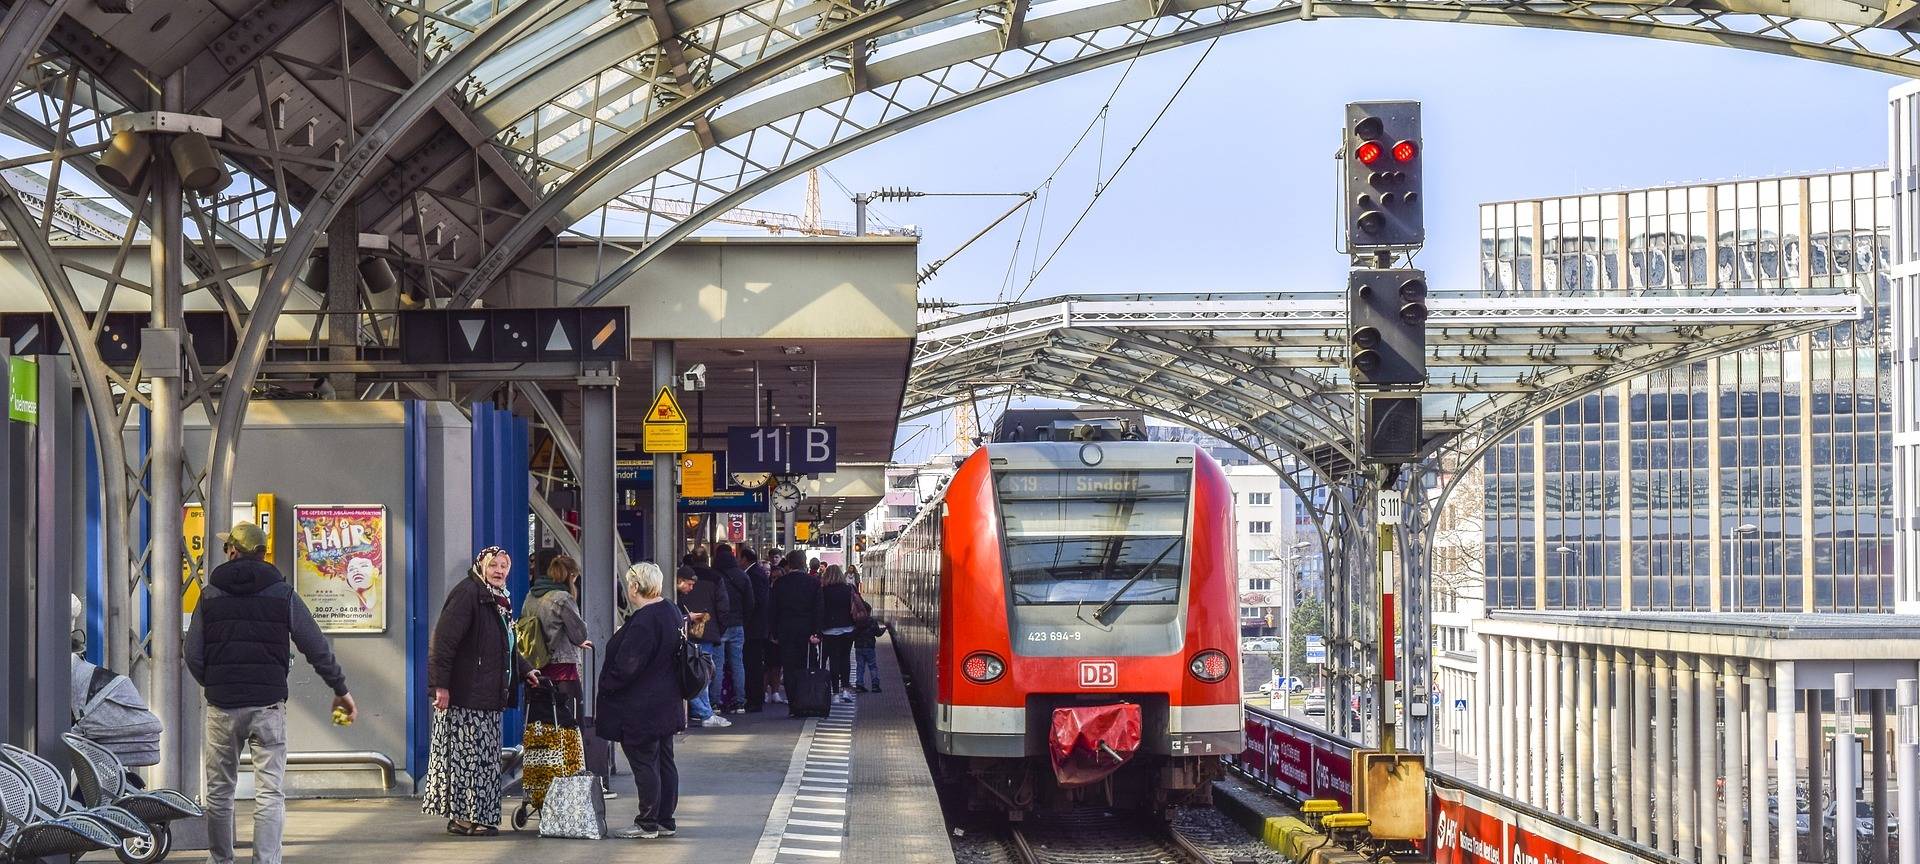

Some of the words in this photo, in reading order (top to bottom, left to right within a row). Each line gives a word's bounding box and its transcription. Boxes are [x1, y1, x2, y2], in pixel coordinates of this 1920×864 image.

[750, 428, 780, 462] 11
[806, 428, 830, 462] B
[1076, 475, 1138, 491] Sindorf
[752, 492, 763, 502] 11
[1388, 498, 1399, 516] 111
[831, 534, 840, 545] C
[1028, 631, 1047, 641] 423
[1050, 631, 1081, 641] 694-9
[1083, 665, 1113, 684] DB
